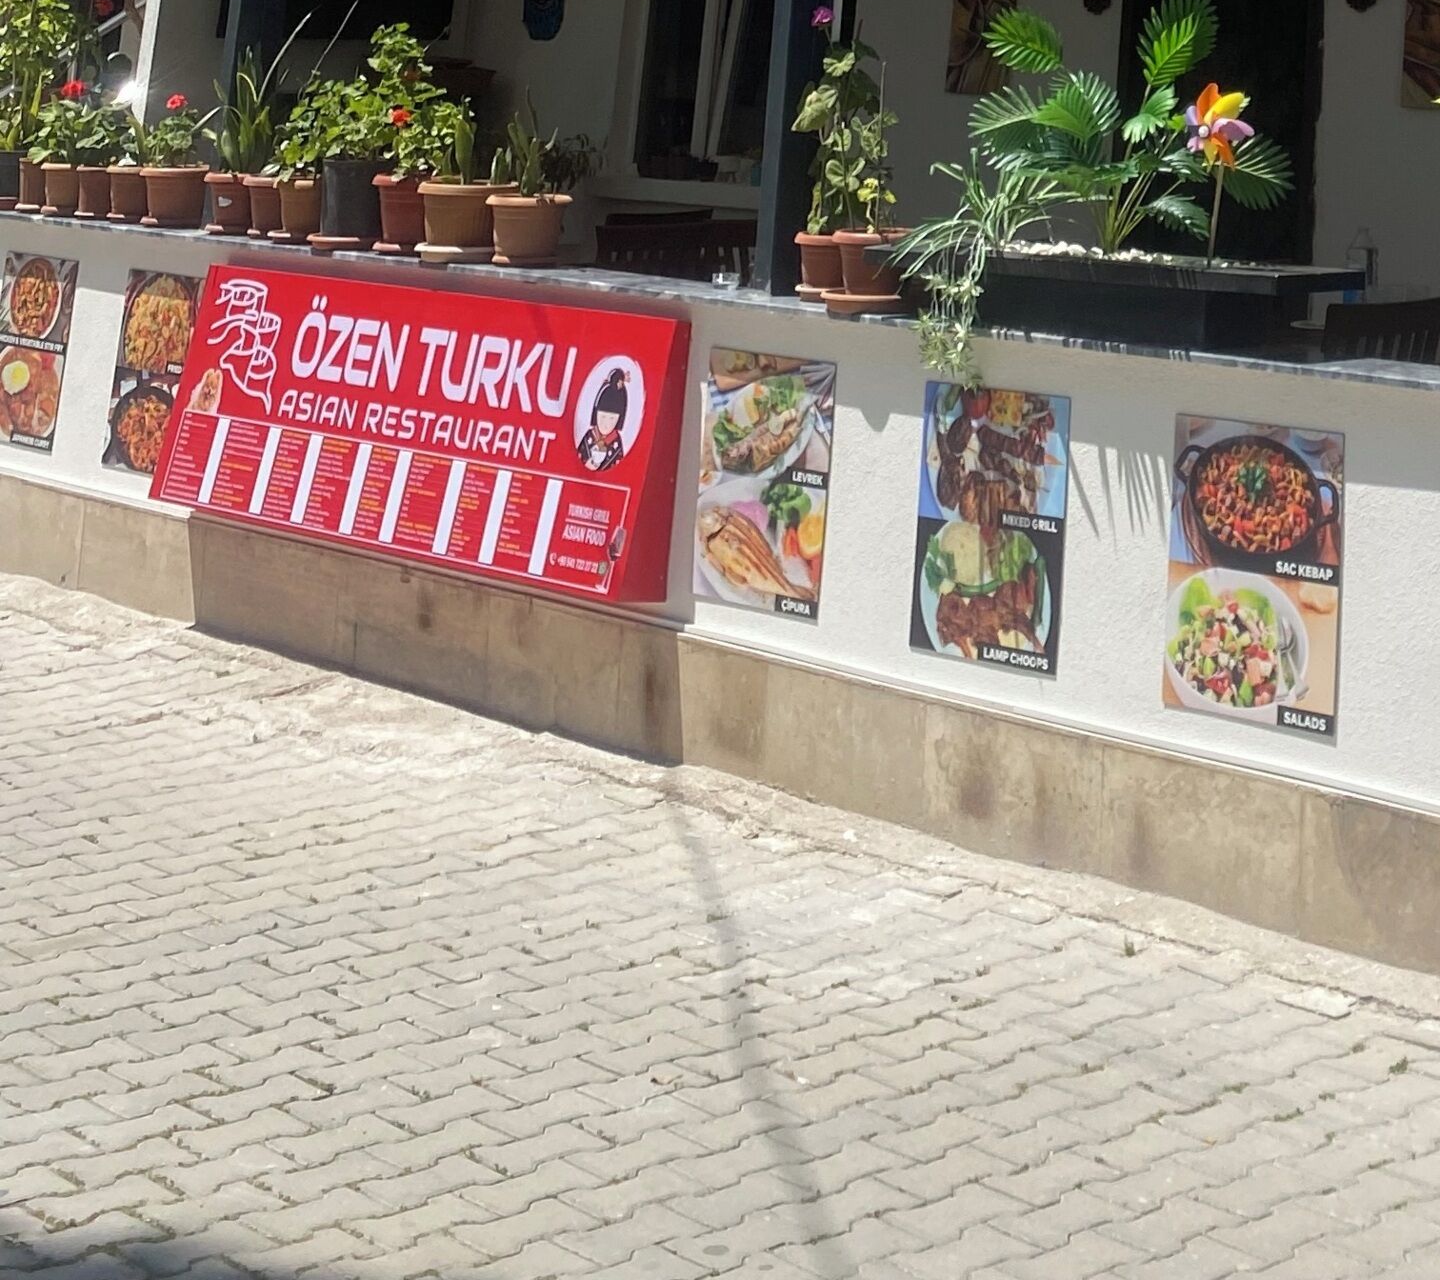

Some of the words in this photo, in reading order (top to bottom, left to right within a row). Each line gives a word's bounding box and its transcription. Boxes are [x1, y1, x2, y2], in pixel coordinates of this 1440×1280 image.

[291, 295, 411, 392] ÖZEN
[418, 327, 578, 418] TURKU
[277, 389, 359, 430] ASIAN
[362, 403, 557, 464] RESTAURANT
[792, 471, 823, 486] LEVREK
[1002, 513, 1031, 528] MIXED
[1031, 518, 1058, 533] GRILL
[562, 524, 586, 544] ASIAN
[585, 527, 606, 547] FOOD
[1275, 560, 1297, 576] SAC
[1298, 564, 1334, 581] KEBAP
[781, 597, 811, 615] ÇİPURA
[983, 646, 1009, 662] LAMP
[1009, 652, 1049, 670] CHOOPS
[1283, 711, 1326, 731] SALADS
